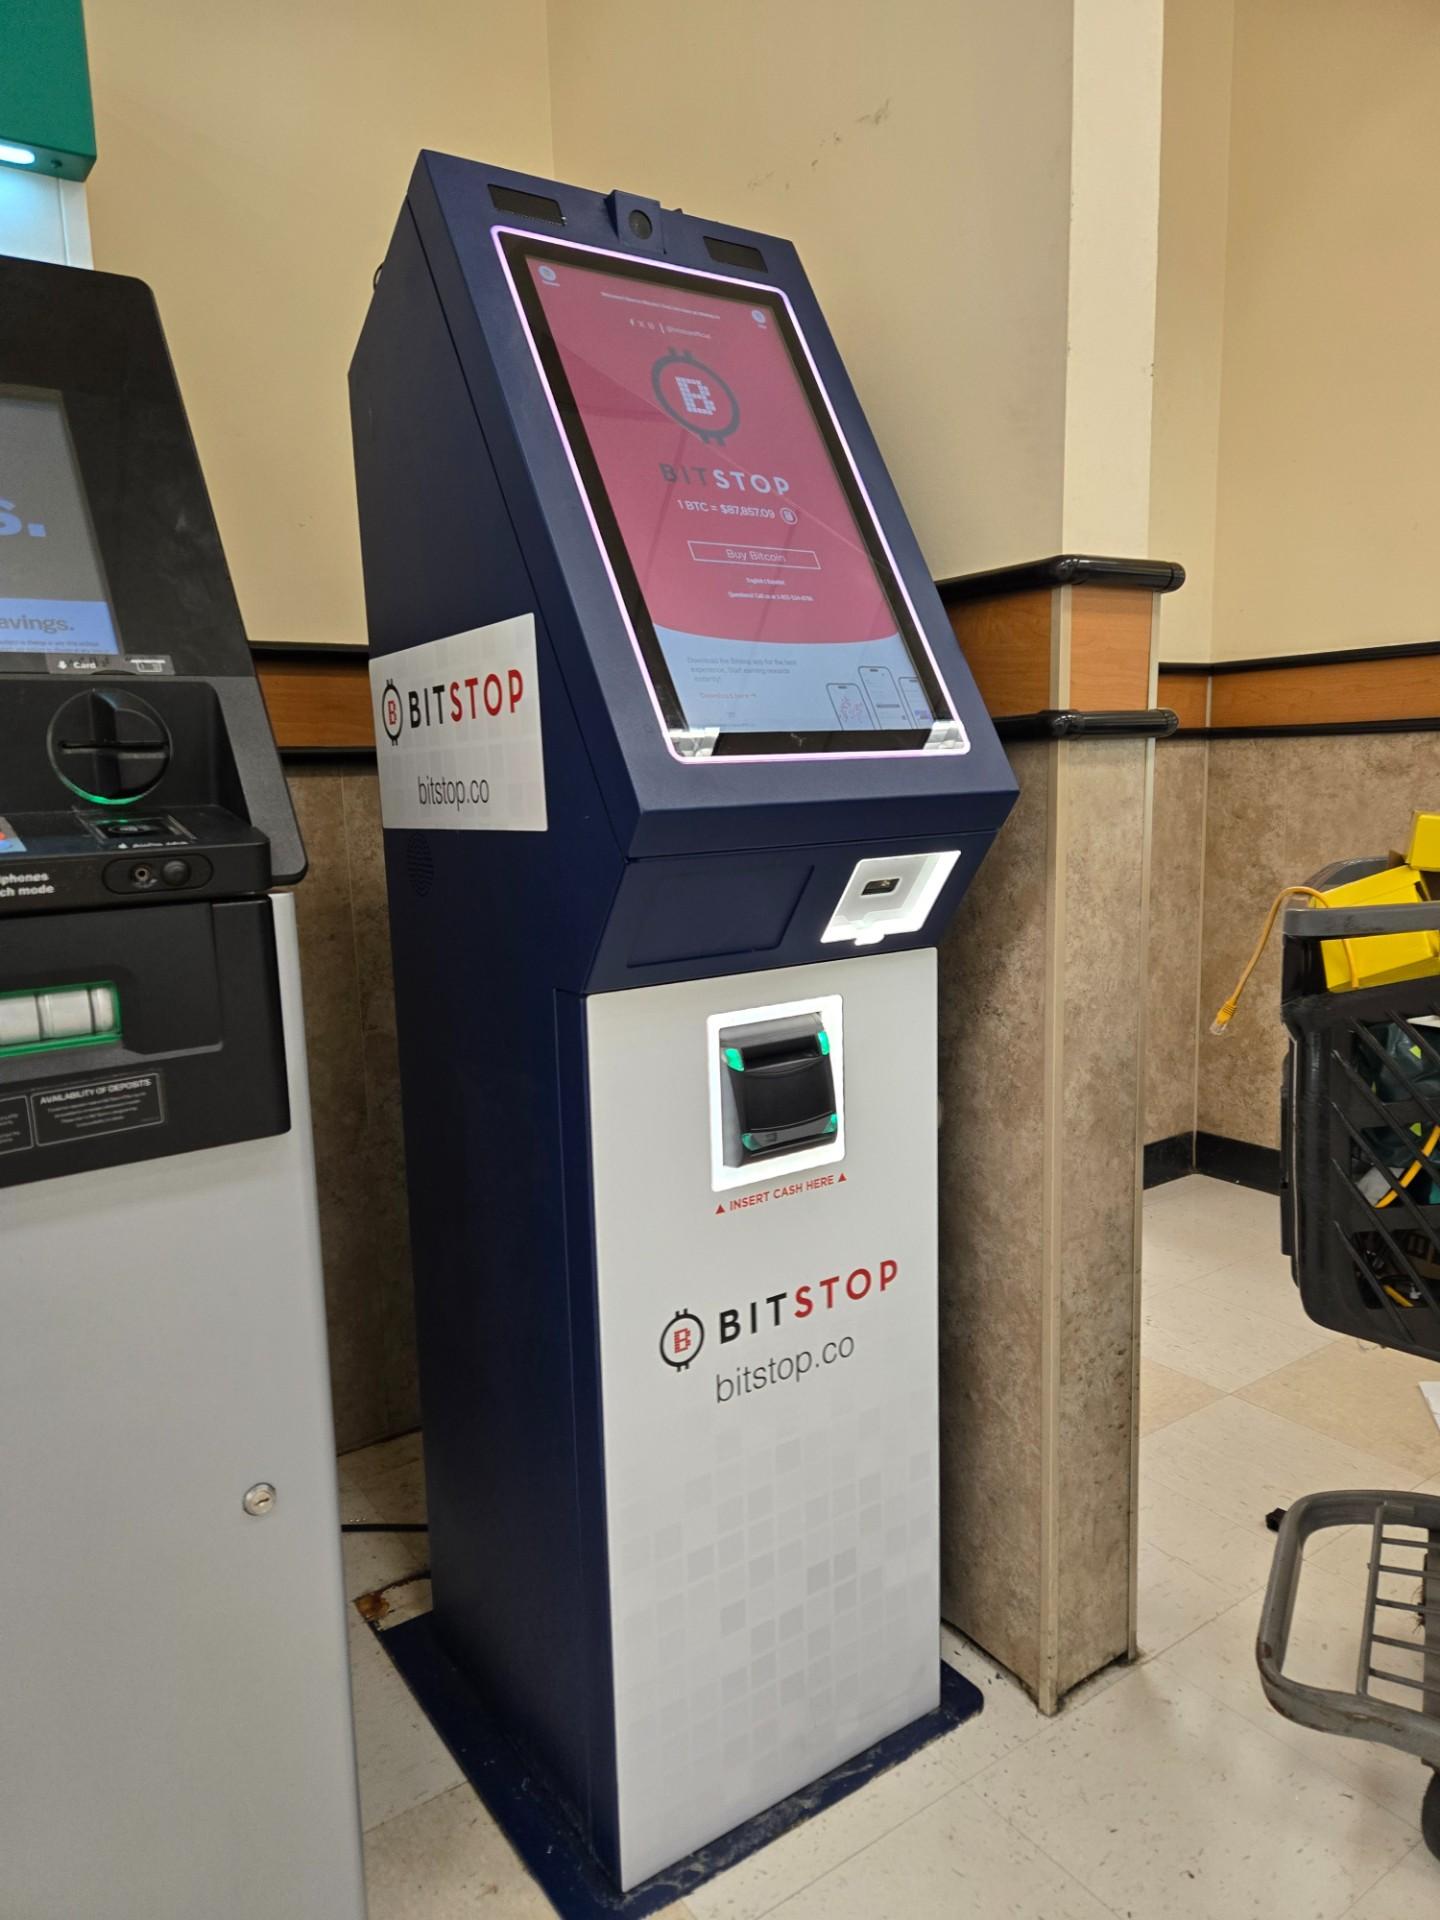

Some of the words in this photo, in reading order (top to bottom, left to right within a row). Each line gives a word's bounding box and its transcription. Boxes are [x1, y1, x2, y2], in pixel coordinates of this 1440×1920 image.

[659, 463, 789, 495] BITSTOP
[685, 501, 709, 513] BTC
[725, 549, 747, 561] Buy
[749, 551, 786, 563] Bitcoin
[408, 669, 524, 729] BITSTOP
[417, 776, 490, 812] bitstop.co
[18, 884, 55, 896] mode
[40, 1087, 94, 1105] AVAILABILITY
[96, 1085, 107, 1095] OF
[108, 1079, 152, 1092] DEPOSITS
[729, 1191, 770, 1211] INSERT
[773, 1183, 803, 1199] CASH
[806, 1175, 835, 1191] HERE
[718, 1259, 898, 1345] BITSTOP
[716, 1336, 855, 1404] bitstop.co
